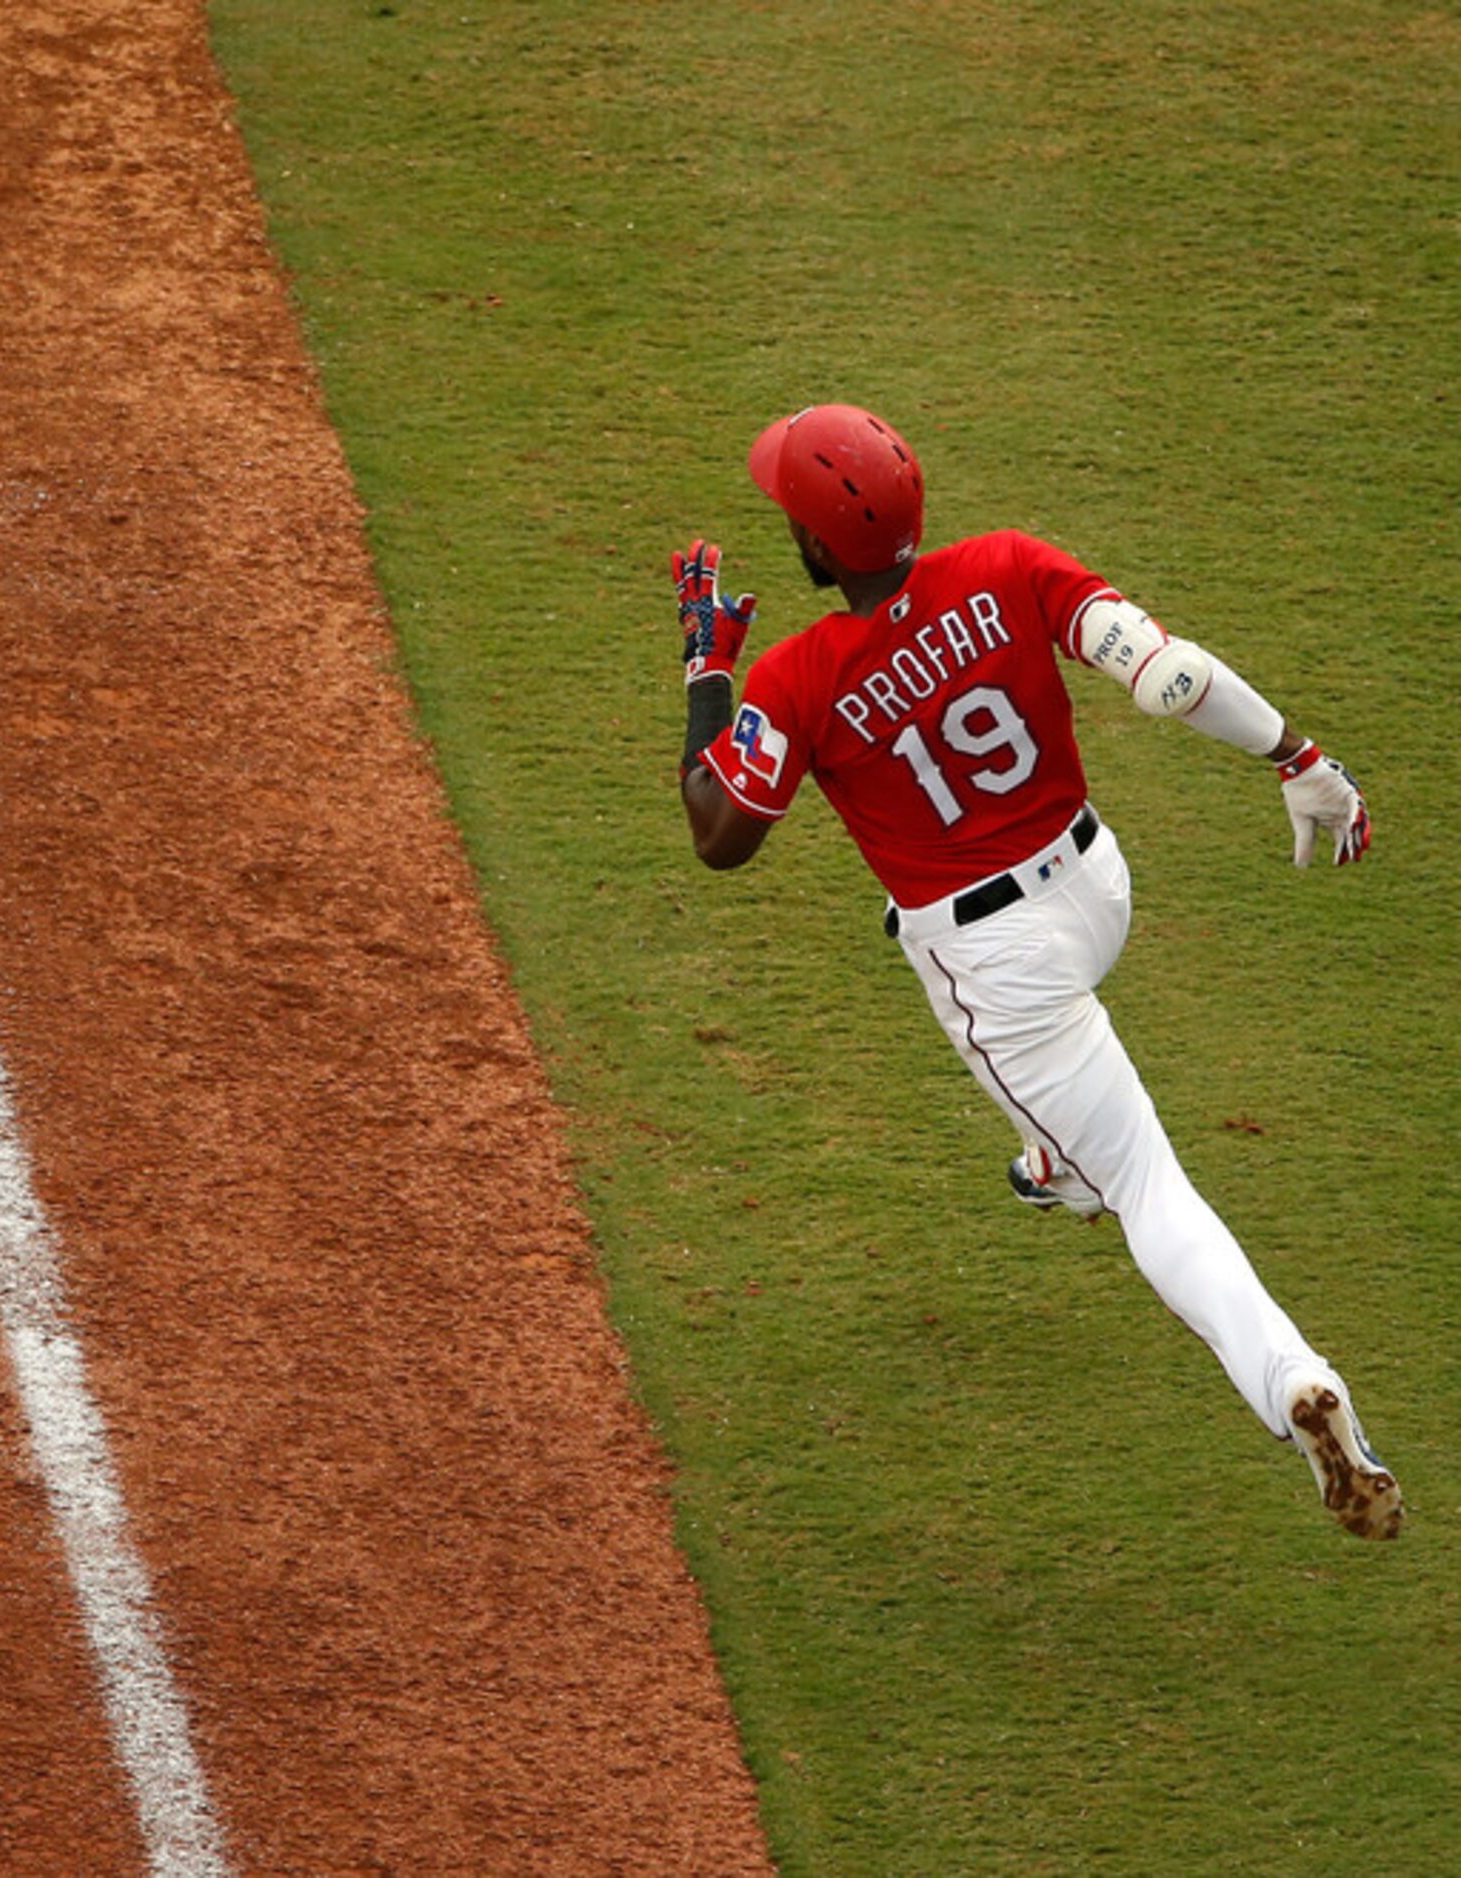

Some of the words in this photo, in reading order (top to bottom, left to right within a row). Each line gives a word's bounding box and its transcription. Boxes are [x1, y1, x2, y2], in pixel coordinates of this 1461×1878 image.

[835, 592, 1010, 743] PROFAR
[1092, 621, 1123, 665] PROF
[1115, 644, 1134, 667] 19
[892, 686, 1039, 826] 19
